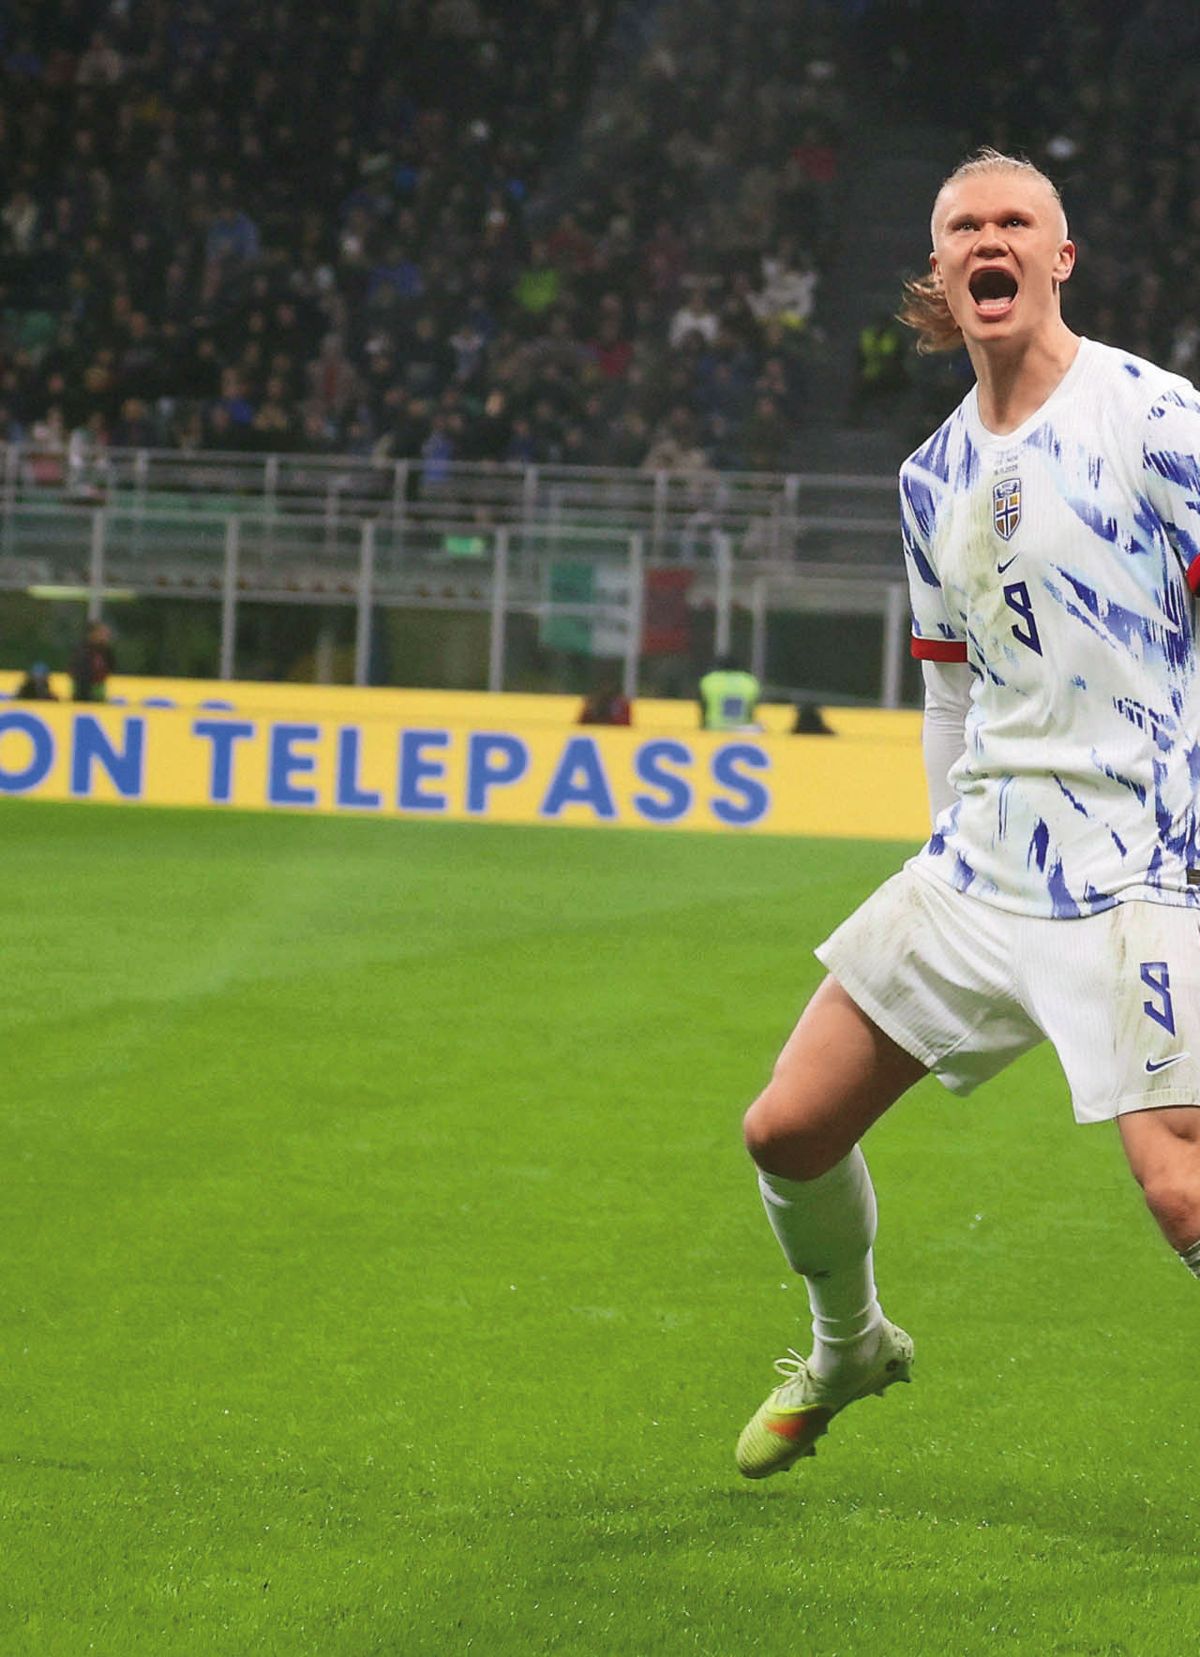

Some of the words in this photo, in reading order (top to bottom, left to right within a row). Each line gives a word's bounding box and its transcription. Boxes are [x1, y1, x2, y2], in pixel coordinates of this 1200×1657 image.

[1003, 581, 1043, 657] 9
[0, 711, 144, 798] ON
[193, 718, 770, 826] TELEPASS
[1140, 962, 1175, 1037] 9
